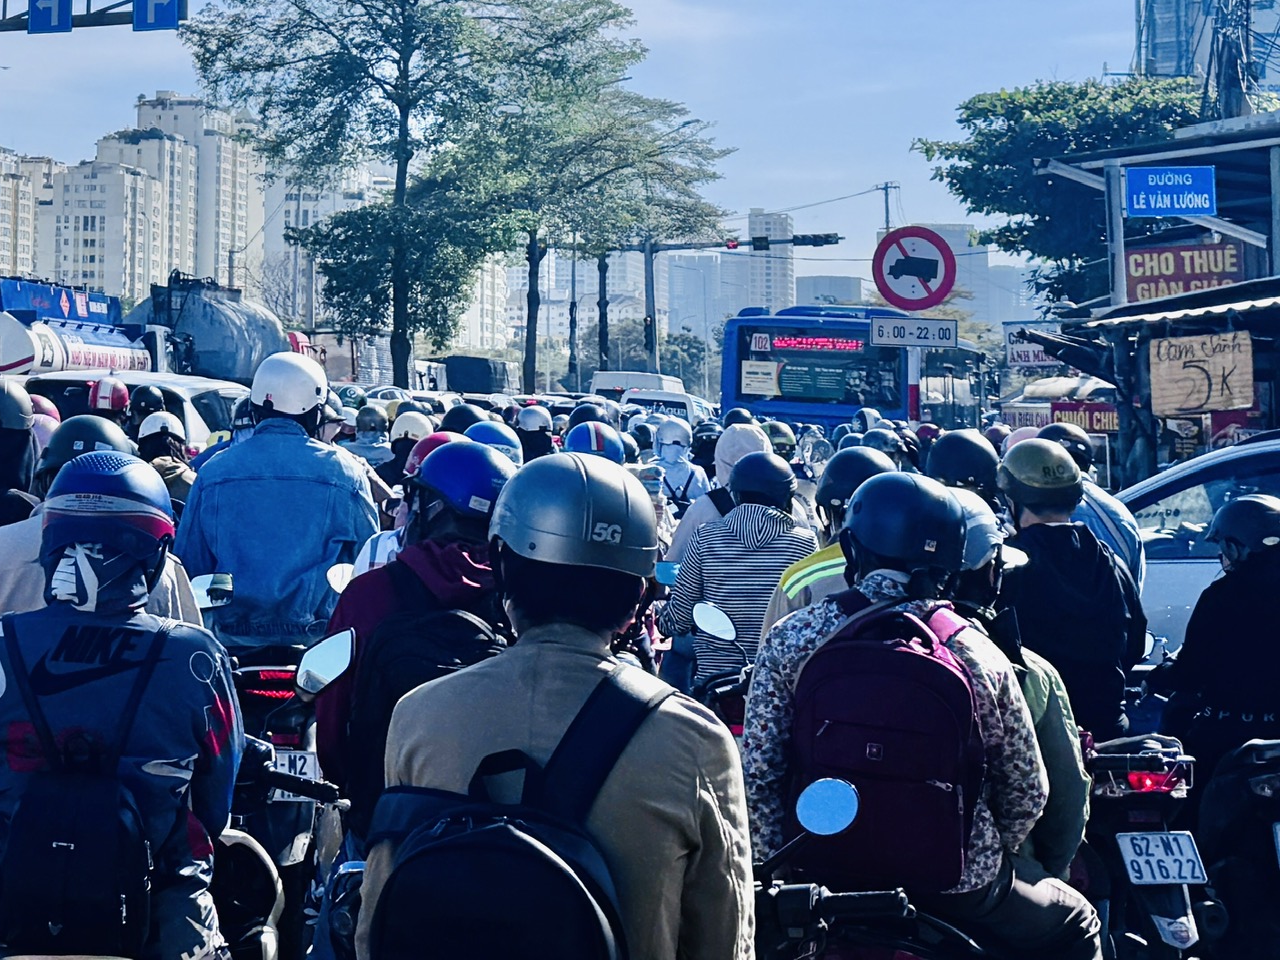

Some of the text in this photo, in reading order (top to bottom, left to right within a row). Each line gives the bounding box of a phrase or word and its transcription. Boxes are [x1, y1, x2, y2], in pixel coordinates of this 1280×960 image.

[1147, 171, 1193, 186] ĐƯỜNG
[1133, 190, 1210, 209] LÊ VĂN LƯƠNG
[1129, 244, 1238, 277] CHO THUÊ
[753, 335, 769, 350] 102
[592, 522, 622, 544] 5G
[49, 625, 146, 666] NIKE
[1129, 836, 1184, 858] 62-N1
[1129, 858, 1201, 881] 916.22
